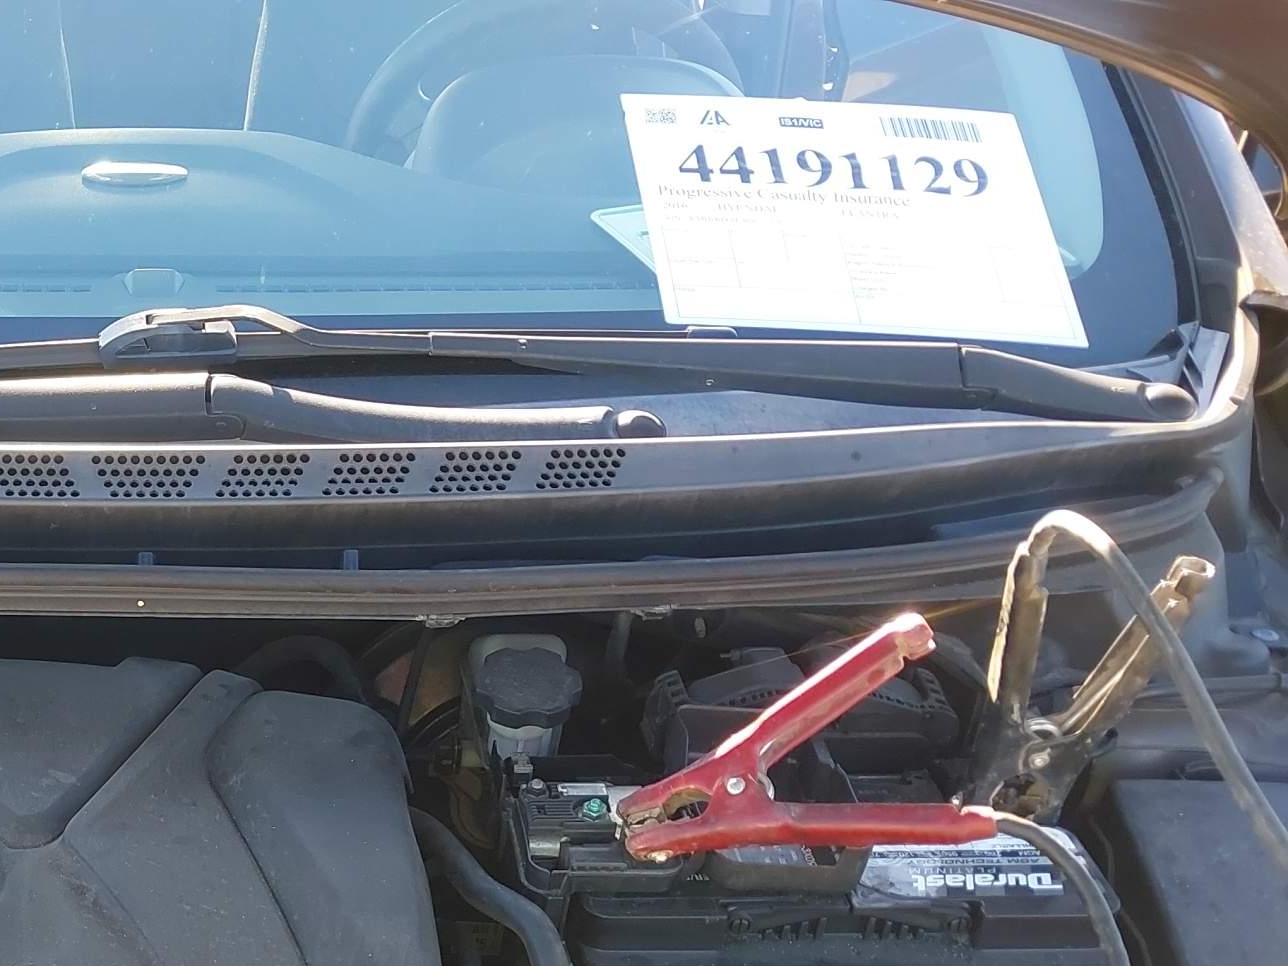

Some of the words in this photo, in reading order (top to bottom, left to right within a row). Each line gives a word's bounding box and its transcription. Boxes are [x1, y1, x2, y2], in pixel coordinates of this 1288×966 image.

[678, 143, 989, 198] 44191129
[658, 184, 752, 201] Progressive
[756, 189, 828, 205] Casualty
[834, 193, 911, 208] Insurance
[907, 858, 1001, 866] TECHNOLOGY
[911, 872, 1064, 890] Duralast
